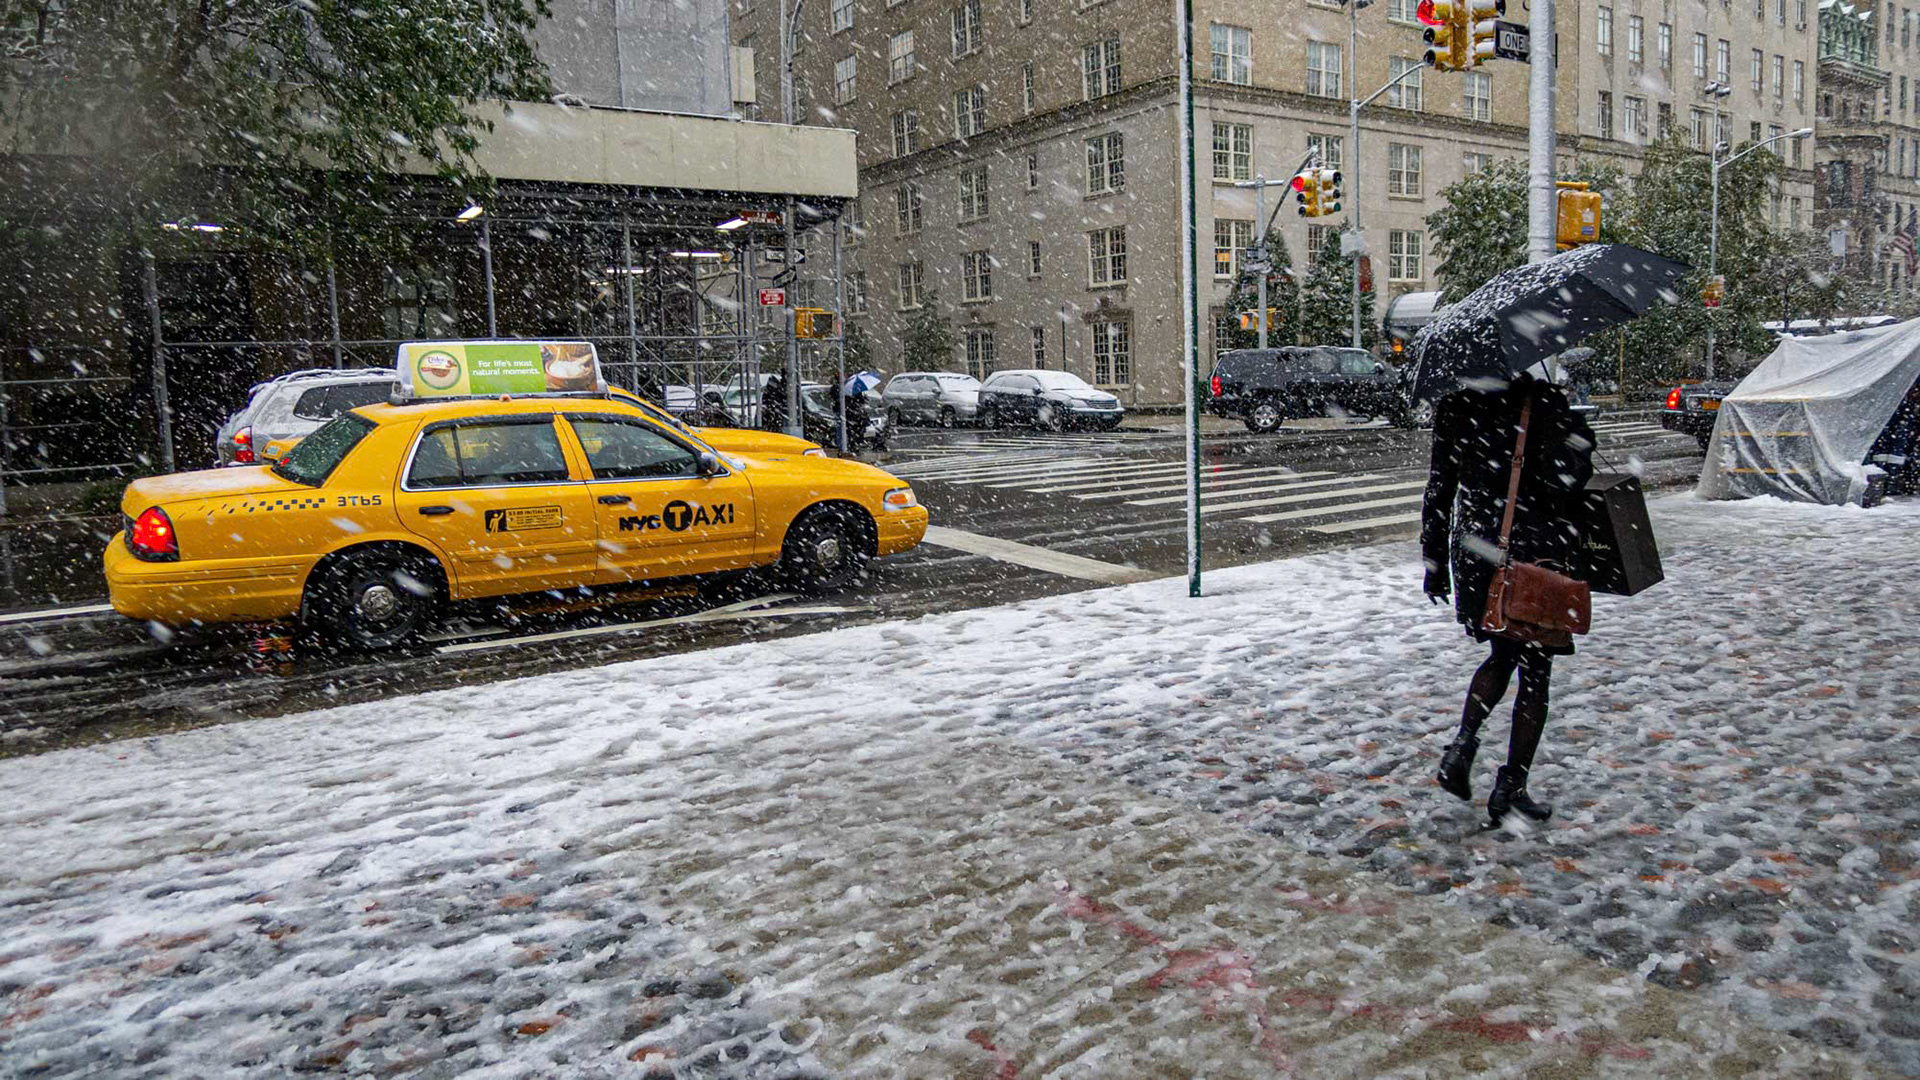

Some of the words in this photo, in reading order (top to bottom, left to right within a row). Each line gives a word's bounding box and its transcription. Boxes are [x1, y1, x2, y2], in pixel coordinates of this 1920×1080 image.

[1505, 33, 1524, 50] ONE
[478, 360, 491, 368] For
[493, 359, 511, 368] life's
[513, 360, 533, 368] most
[472, 367, 500, 376] natural
[503, 367, 541, 376] moments.
[619, 514, 661, 531] NYC
[663, 500, 734, 532] TAXI
